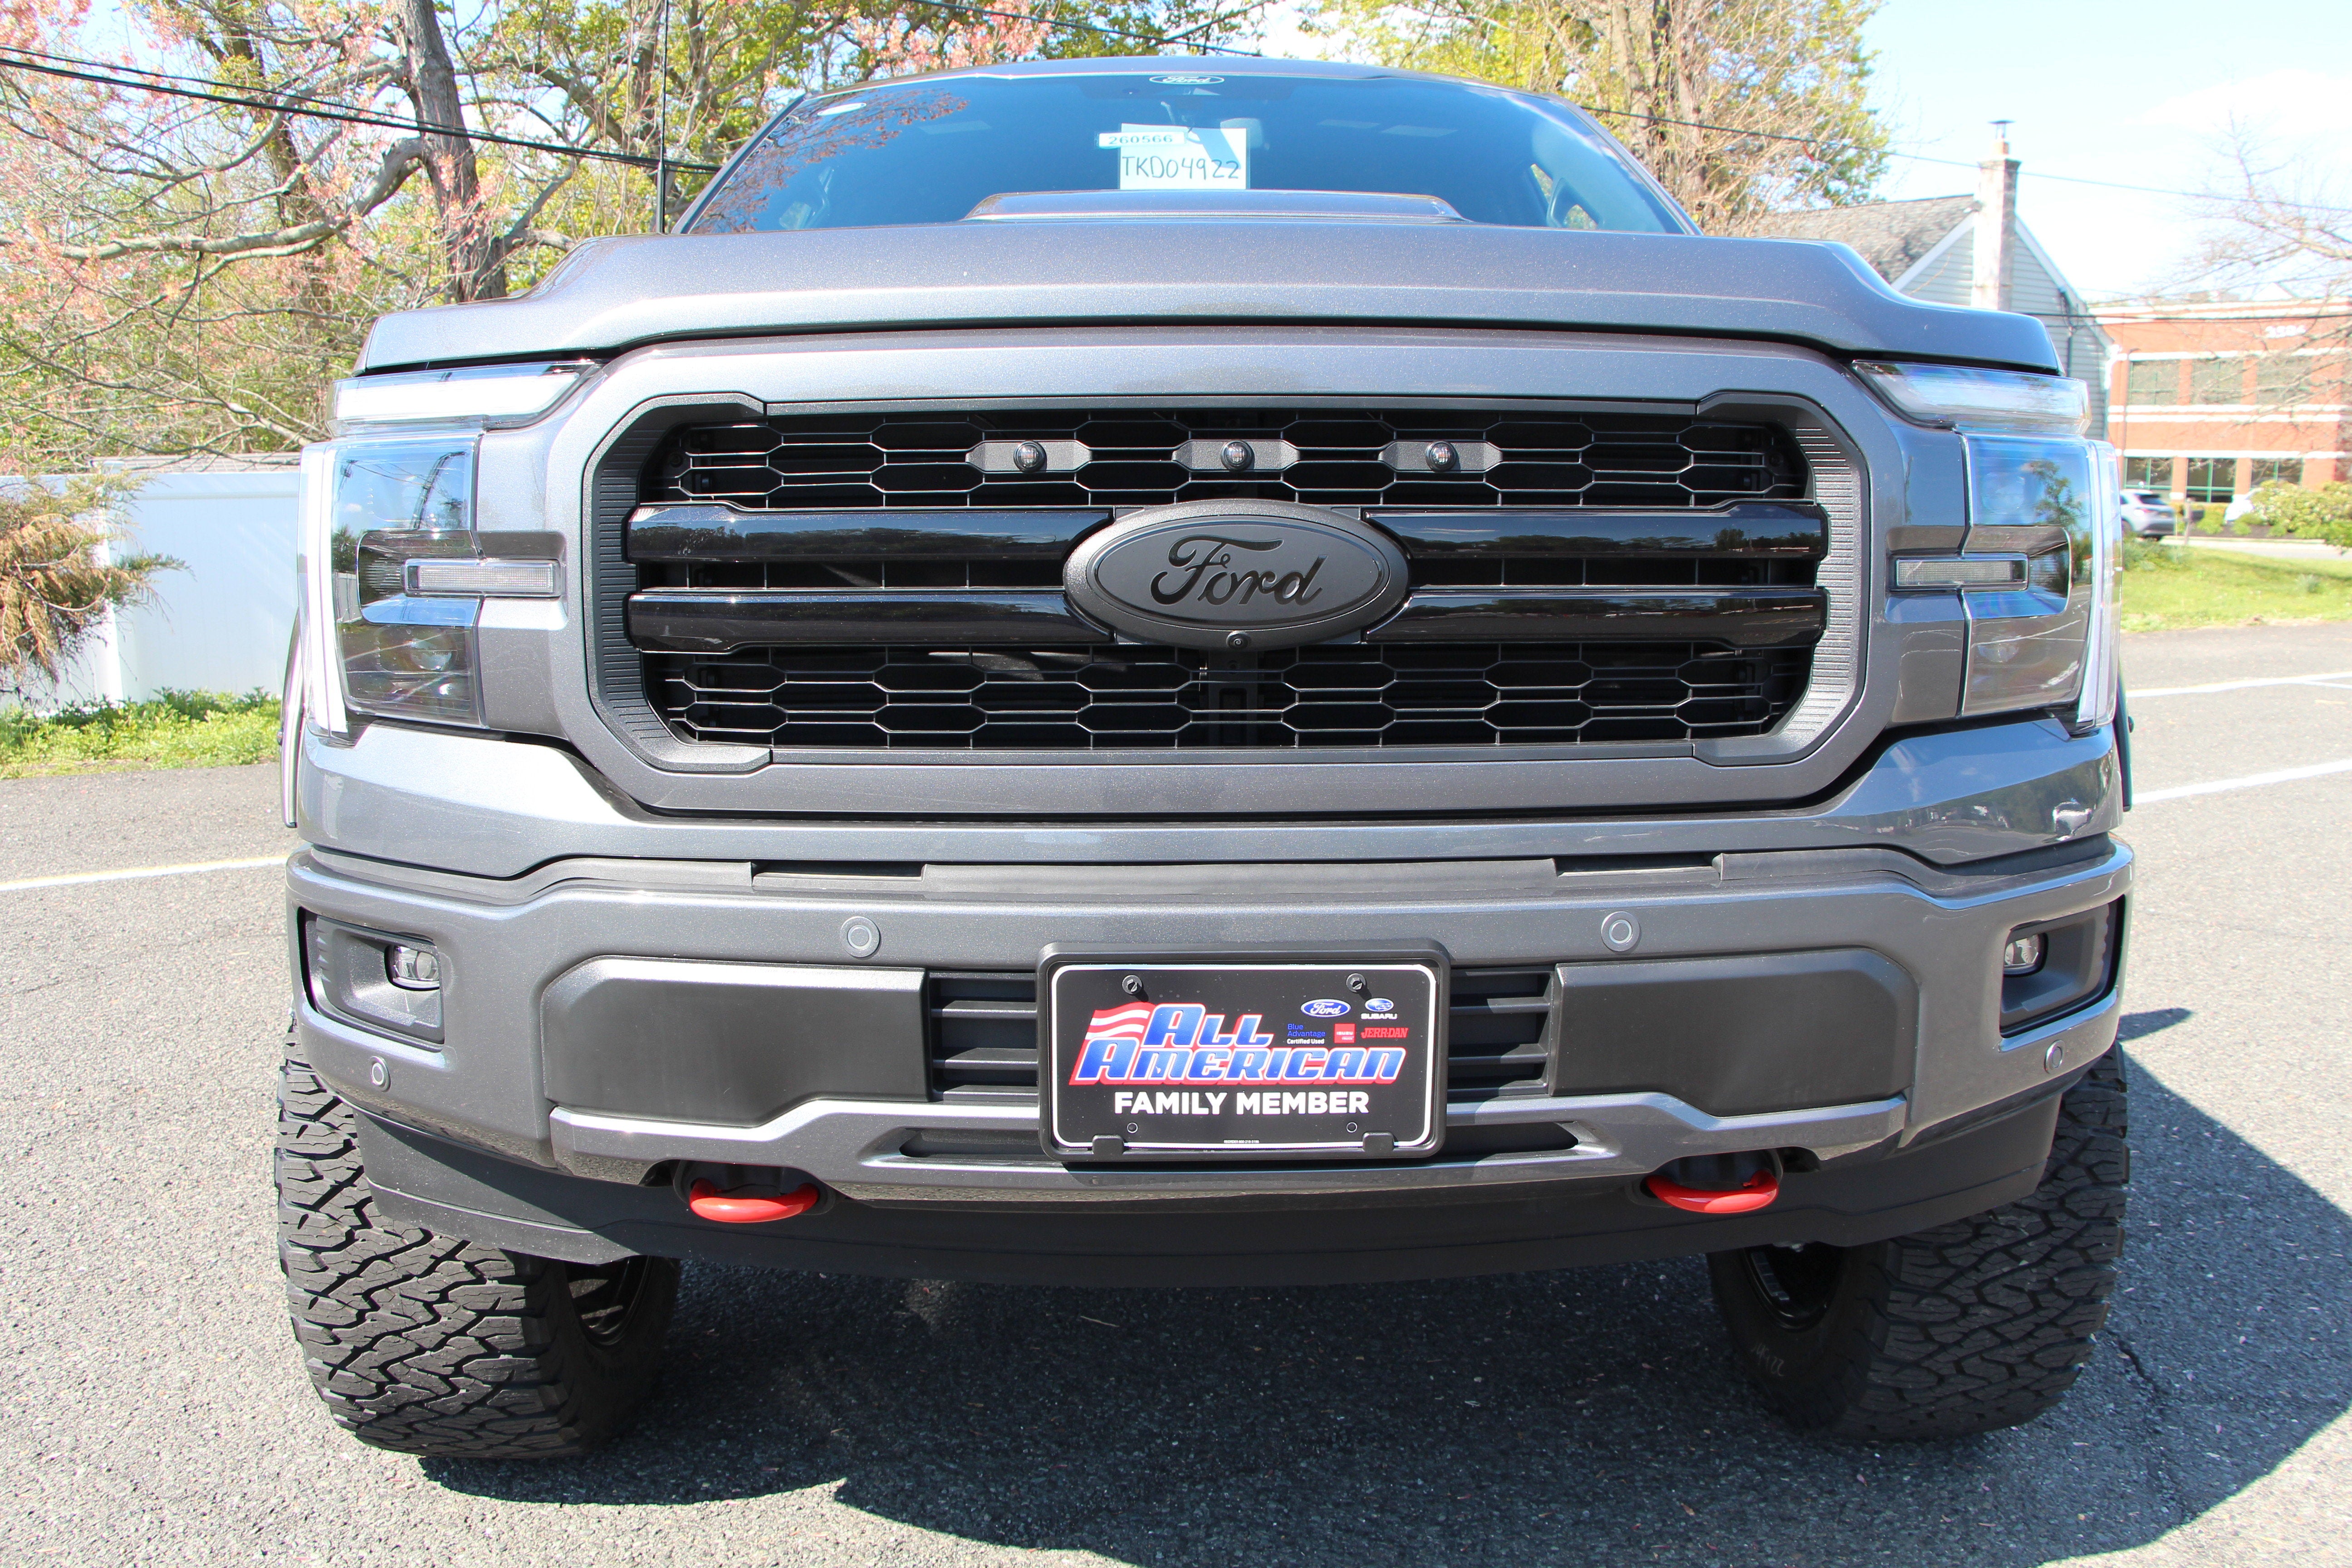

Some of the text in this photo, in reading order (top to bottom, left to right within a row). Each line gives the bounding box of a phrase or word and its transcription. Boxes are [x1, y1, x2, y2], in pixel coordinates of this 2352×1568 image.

[1109, 134, 1173, 145] 260566
[1151, 534, 1328, 606] Ford
[1310, 1001, 1342, 1014] Ford
[1115, 1092, 1369, 1115] FAMILY MEMBER
